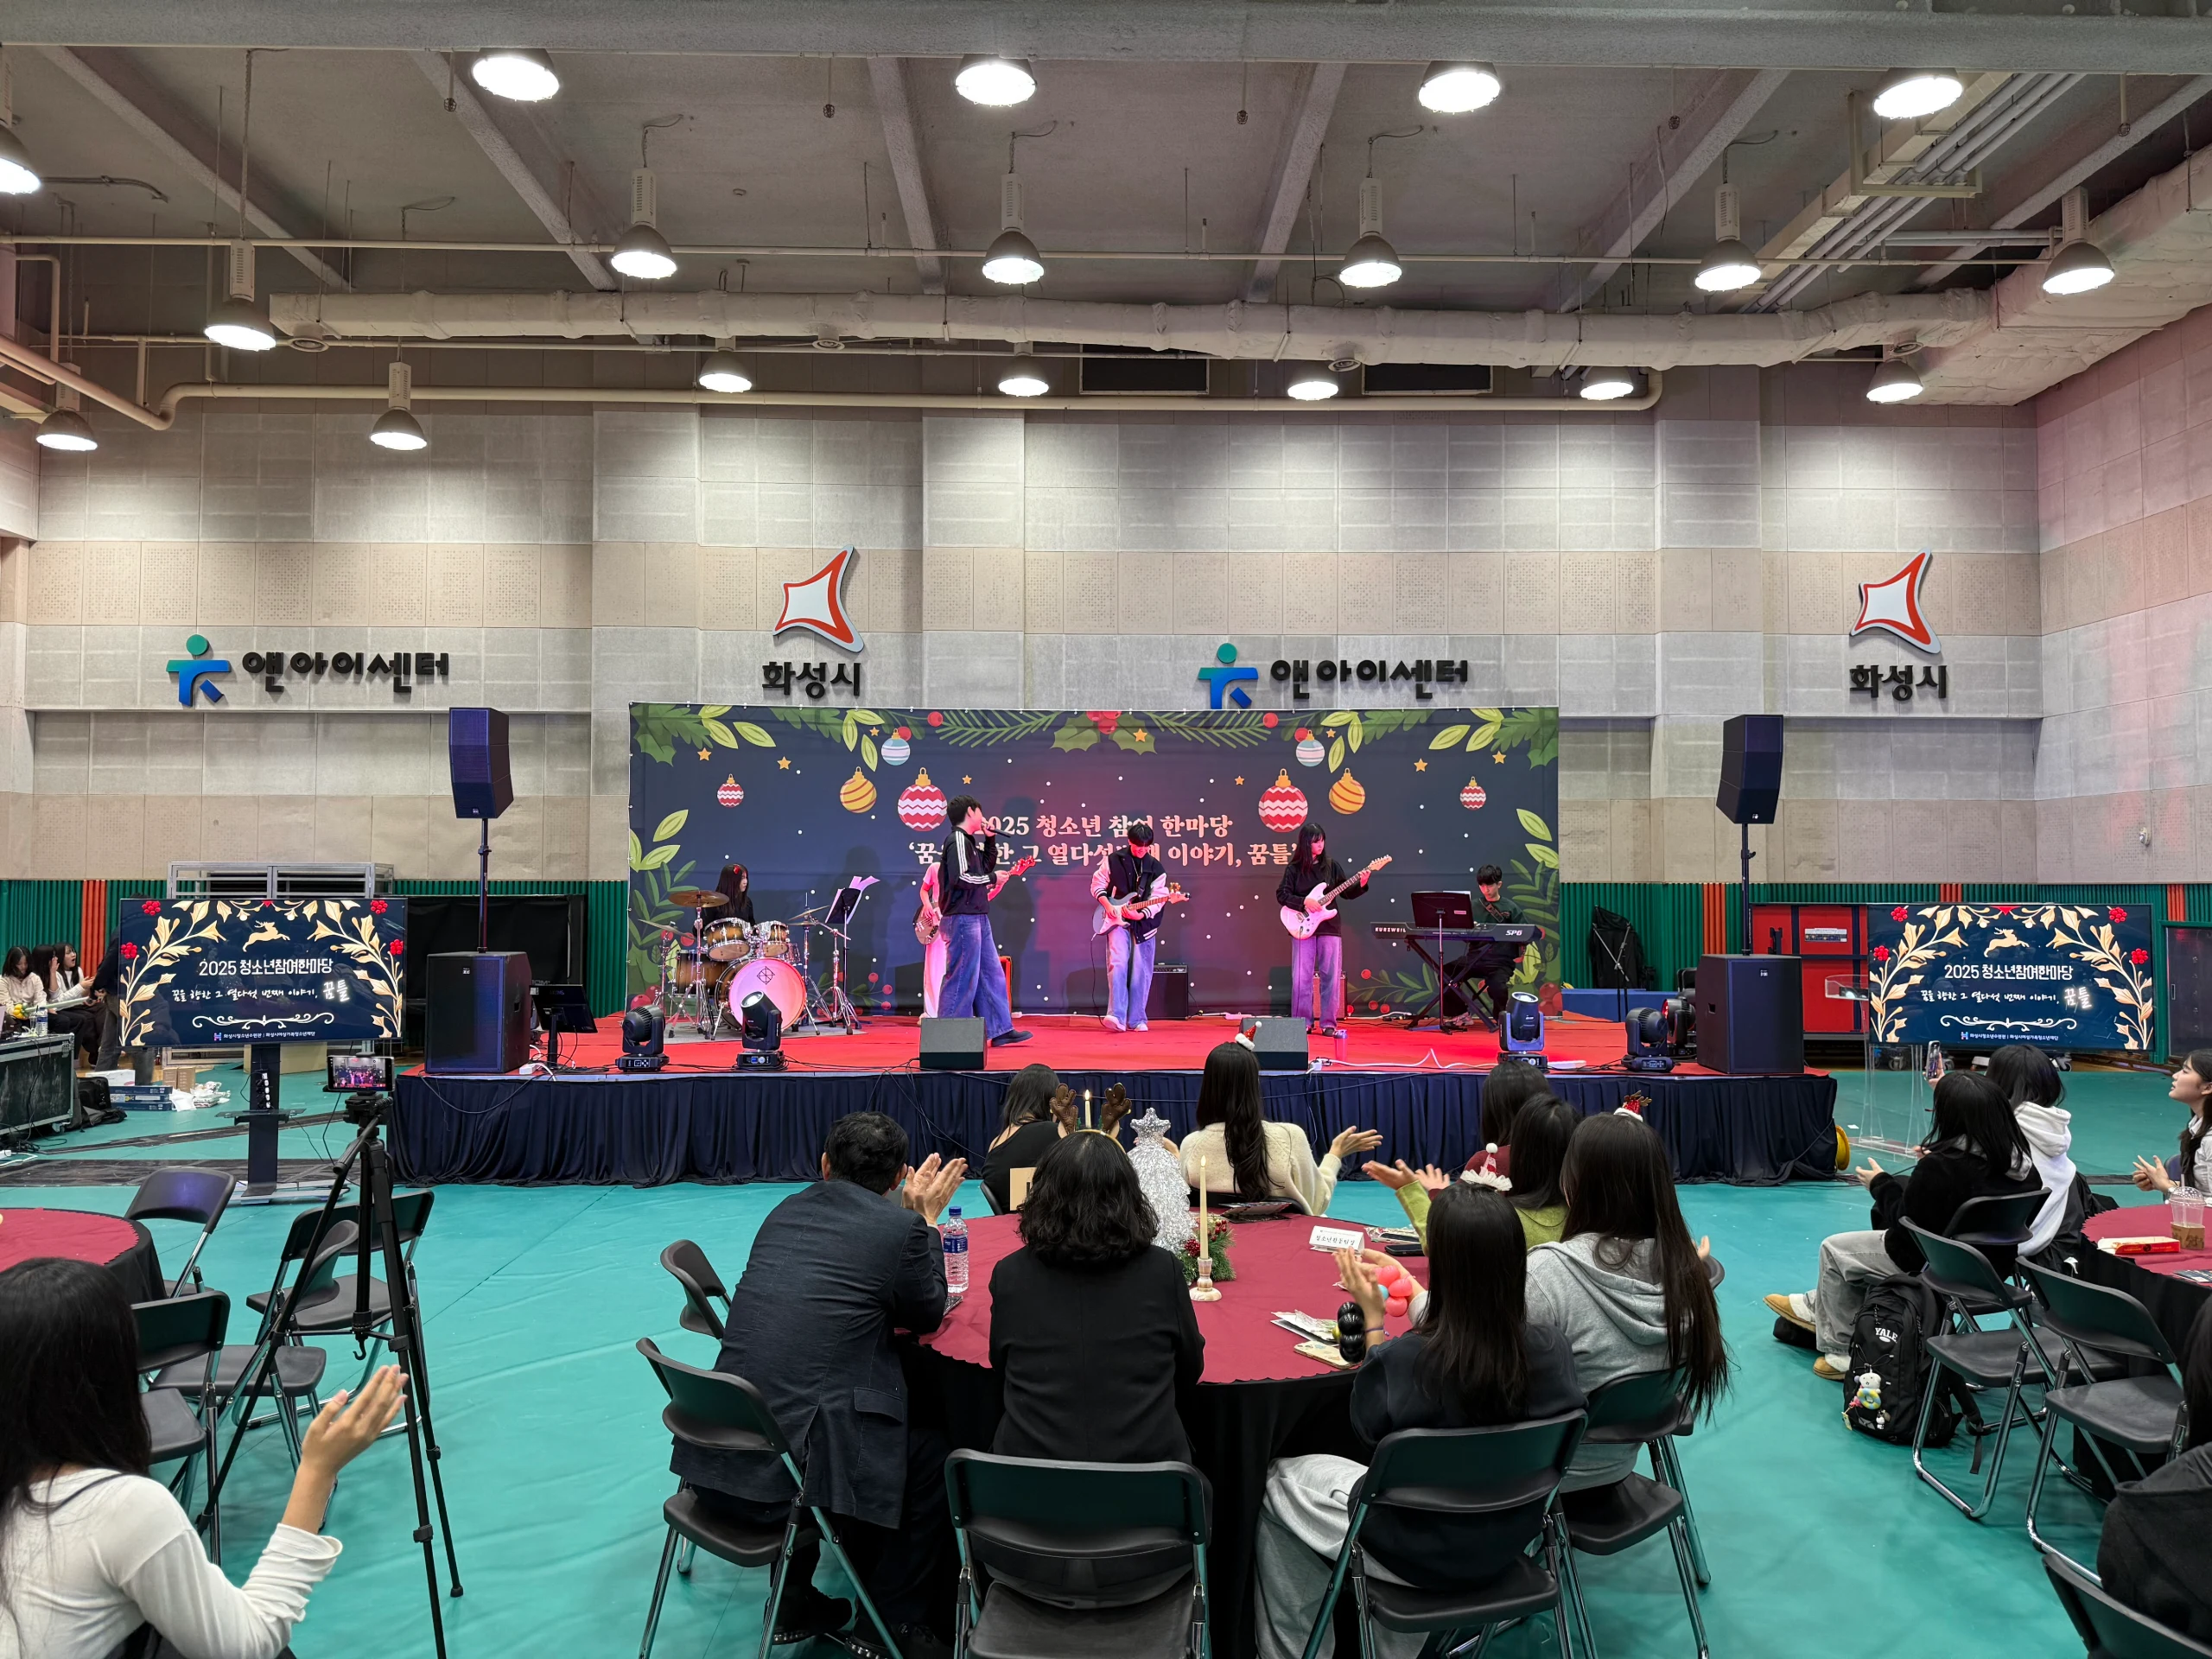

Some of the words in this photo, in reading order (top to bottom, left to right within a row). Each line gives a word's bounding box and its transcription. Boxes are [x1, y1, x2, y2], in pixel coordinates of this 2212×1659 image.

[242, 652, 449, 692] 앤아이센터
[761, 661, 861, 699] 화성시
[1270, 660, 1468, 699] 앤아이센터
[1849, 664, 1948, 701] 화성시
[974, 816, 1029, 836] 025
[1036, 815, 1102, 837] 청소년
[1160, 815, 1233, 837] 한마당
[908, 842, 946, 865] ‘꿈
[1048, 842, 1114, 866] 열다섯
[1168, 842, 1242, 868] 이야기,
[199, 960, 237, 976] 2025
[239, 957, 334, 976] 청소년참여한마당
[1944, 964, 1980, 979] 2025
[1981, 963, 2074, 981] 청소년참여한마당
[171, 988, 188, 1002] 꿈을
[189, 989, 212, 1001] 향한
[227, 988, 257, 1001] 열다섯
[262, 989, 284, 999] 번째
[322, 979, 350, 1002] 꿈틀
[1920, 989, 1936, 1002] 꿈을
[1937, 990, 1957, 1001] 향한
[1971, 990, 2001, 1003] 열다섯
[2004, 993, 2026, 1002] 번째
[2063, 986, 2093, 1009] 꿈틀
[1874, 1327, 1898, 1344] YALE
